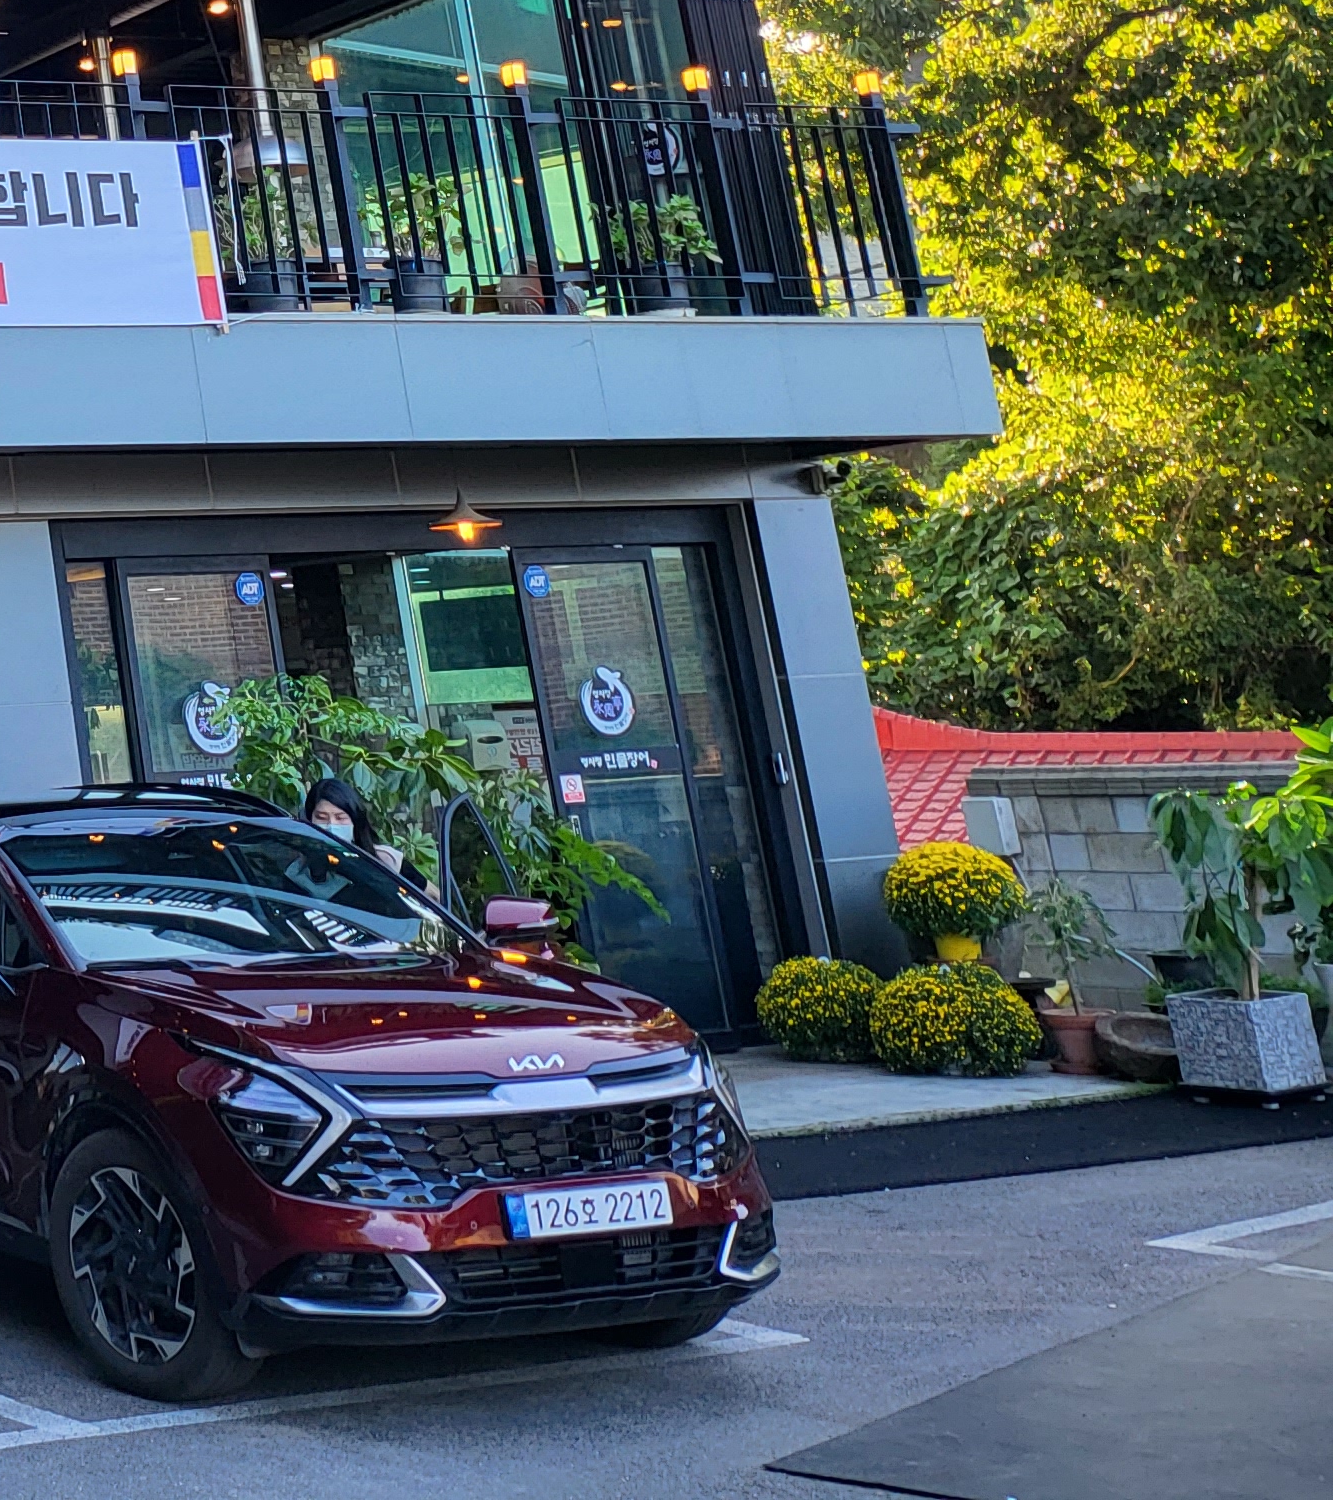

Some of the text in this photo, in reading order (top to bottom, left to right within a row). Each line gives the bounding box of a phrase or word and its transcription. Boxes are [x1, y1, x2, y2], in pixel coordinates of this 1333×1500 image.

[242, 582, 259, 595] ADT
[530, 575, 546, 587] ADT
[604, 750, 650, 770] 민물장어
[604, 1188, 667, 1224] 2212
